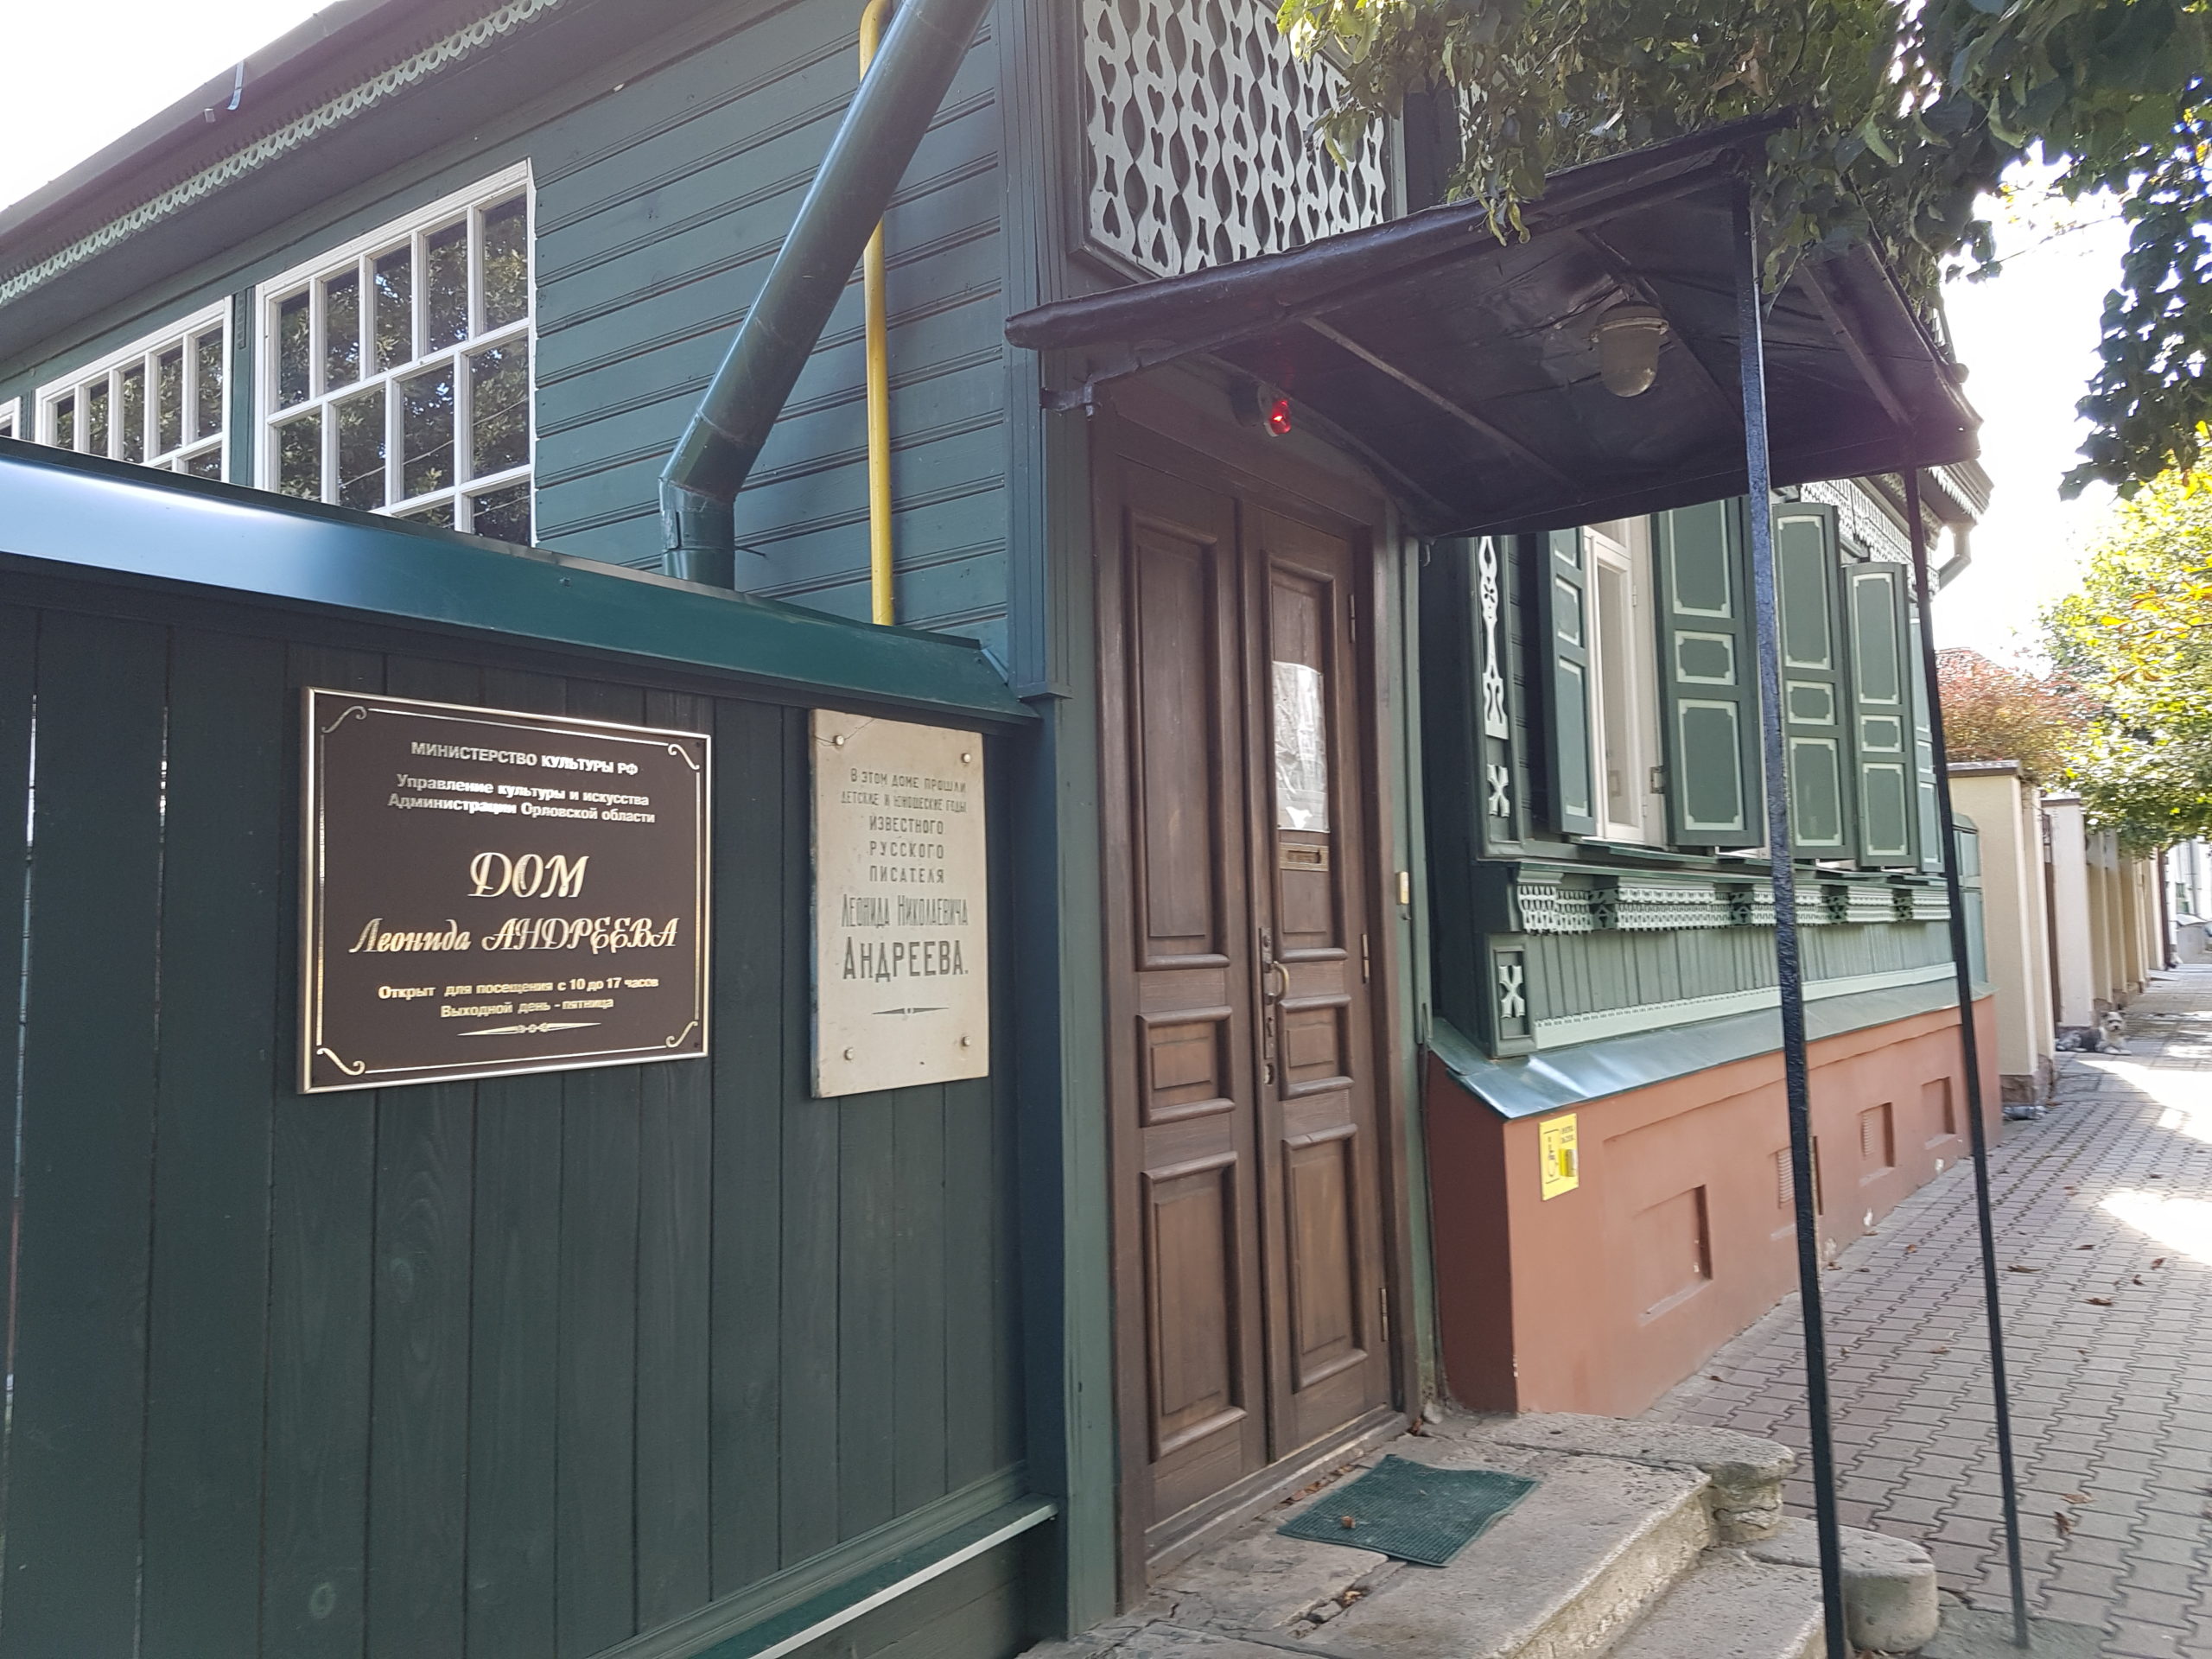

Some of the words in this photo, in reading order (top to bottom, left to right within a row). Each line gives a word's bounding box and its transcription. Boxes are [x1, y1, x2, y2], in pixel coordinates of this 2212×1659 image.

[411, 741, 537, 766] МИНИСТЕРСТВО
[541, 755, 613, 774] КУЛЬТУРЫ
[618, 763, 639, 775] РФ
[397, 773, 493, 794] Управление
[498, 785, 565, 801] культуры
[569, 791, 579, 800] и
[582, 791, 649, 806] искусства
[850, 768, 858, 782] В
[861, 771, 887, 785] ЭТОМ
[892, 775, 919, 788] ДОМЕ
[924, 778, 966, 792] ПРОШЛИ
[387, 793, 517, 815] Администрации
[521, 803, 598, 820] Орловской
[601, 810, 655, 823] области
[841, 791, 880, 805] ДЕТСКИЕ
[884, 794, 890, 806] И
[946, 799, 967, 813] ГОДЫ
[869, 815, 944, 835] ИЗВЕСТНОГО
[869, 841, 944, 859] РУССКОГО
[467, 852, 589, 898] ДОМ
[869, 865, 944, 883] ПИСАТЕЛЯ
[348, 918, 471, 952] Леонида
[481, 917, 680, 955] АНДРЕЕВА
[378, 985, 435, 1000] Открыт
[444, 984, 472, 996] для
[476, 982, 553, 995] посещения
[557, 982, 566, 991] с
[569, 978, 586, 990] 10
[587, 980, 604, 992] до
[607, 977, 622, 988] 17
[625, 977, 659, 988] часов
[441, 1001, 512, 1017] Выходной
[518, 1001, 550, 1014] день
[562, 997, 613, 1009] пятница
